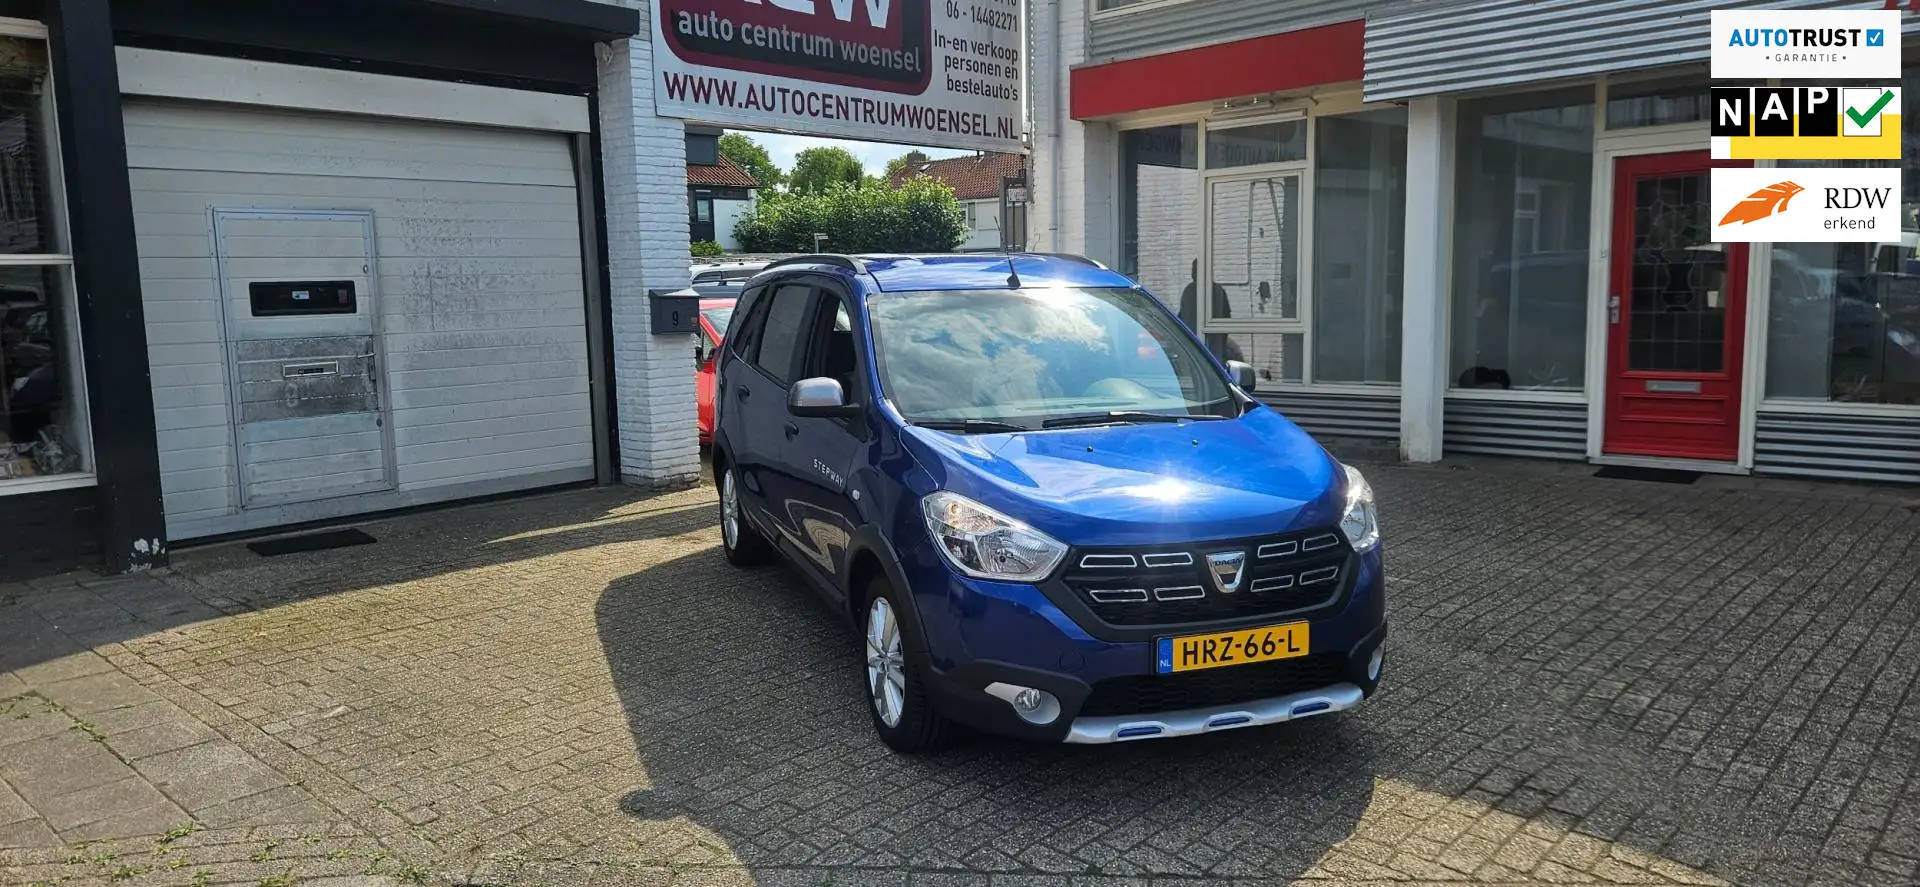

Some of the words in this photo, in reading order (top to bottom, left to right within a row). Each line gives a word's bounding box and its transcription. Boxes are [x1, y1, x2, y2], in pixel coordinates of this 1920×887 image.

[946, 0, 959, 20] 06
[971, 5, 1018, 33] 14482271
[678, 10, 734, 42] auto
[740, 22, 835, 58] centrum
[839, 39, 921, 73] woensel
[934, 29, 968, 53] In-en
[971, 40, 1018, 65] verkoop
[944, 55, 1001, 77] personen
[1004, 65, 1018, 80] en
[947, 74, 1018, 101] bestelauto's
[663, 71, 1018, 140] WWW.AUTOCENTRUMWOENSEL.NL
[813, 458, 844, 487] STEPWAY
[1160, 659, 1171, 668] NL
[1182, 629, 1300, 666] HRZ-66-L
